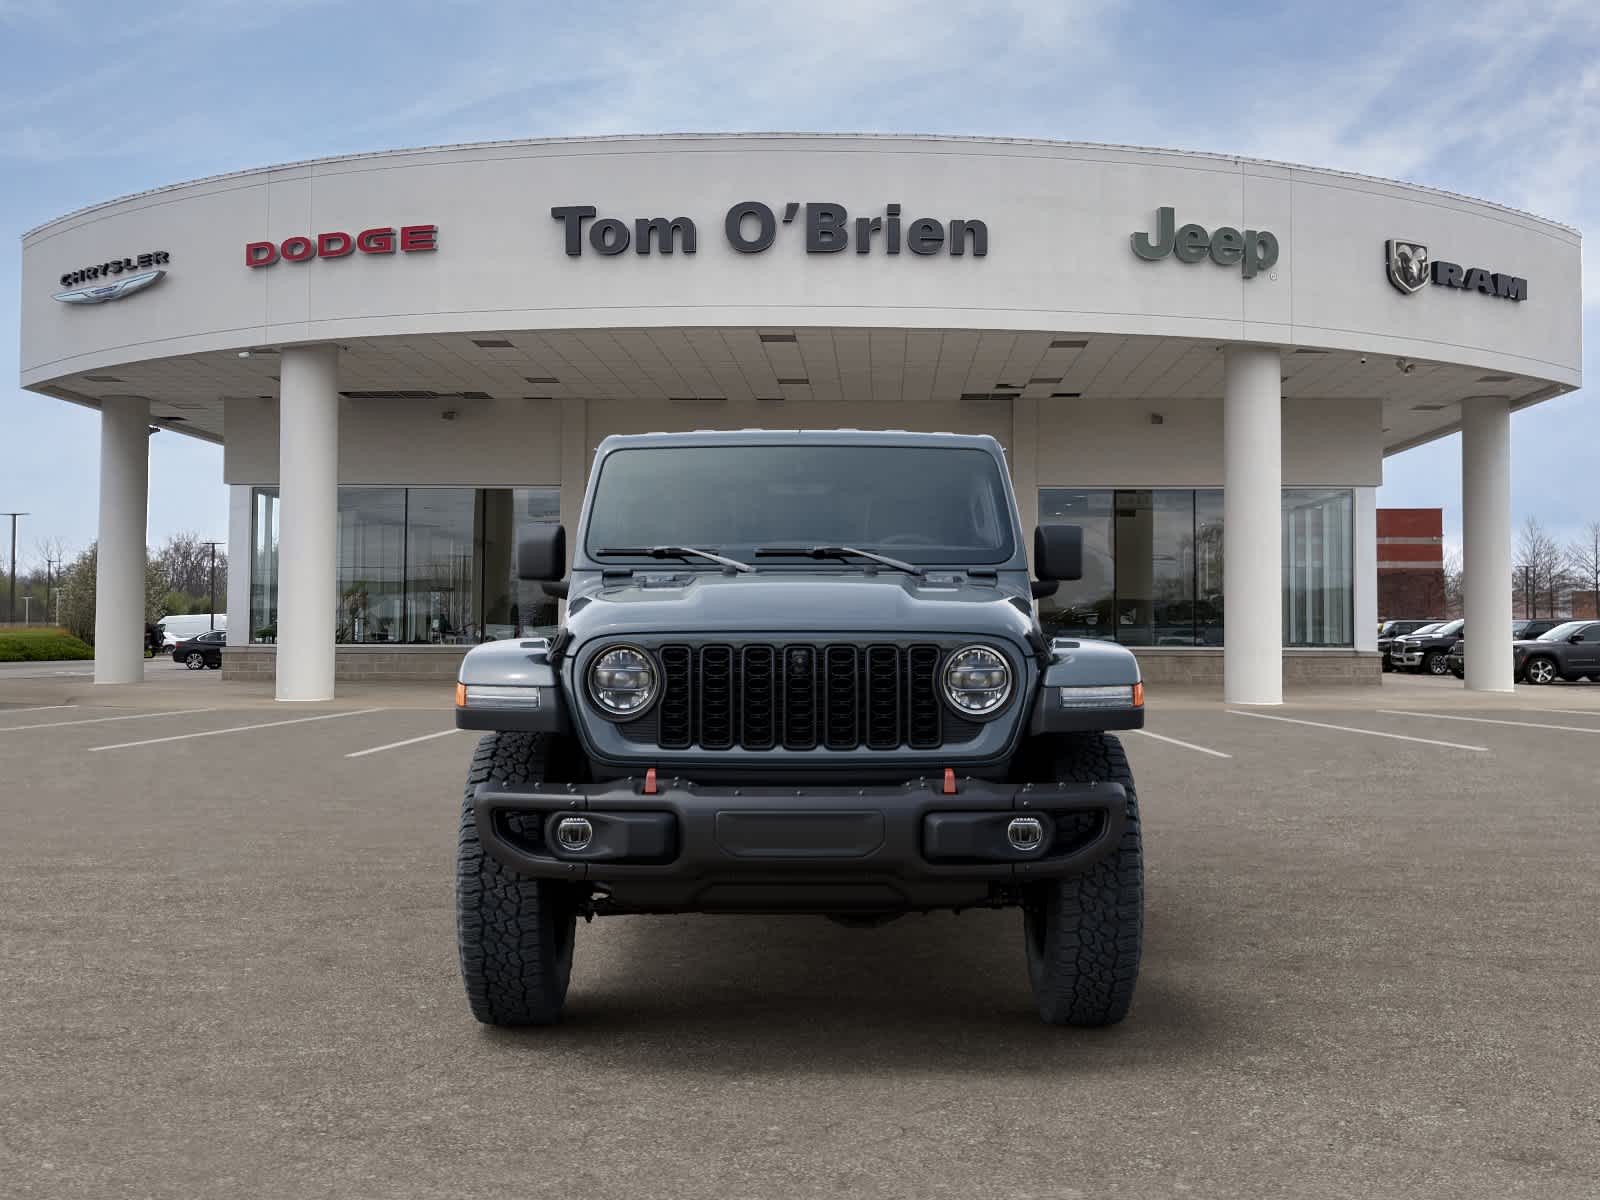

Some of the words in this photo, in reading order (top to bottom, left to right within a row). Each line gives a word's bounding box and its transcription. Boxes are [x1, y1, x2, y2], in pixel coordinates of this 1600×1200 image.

[245, 224, 437, 268] DODGE
[551, 205, 696, 256] Tom
[725, 201, 988, 256] O'Brien
[1131, 207, 1279, 279] Jeep
[60, 249, 170, 287] CHRYSLER
[1431, 261, 1527, 301] RAM
